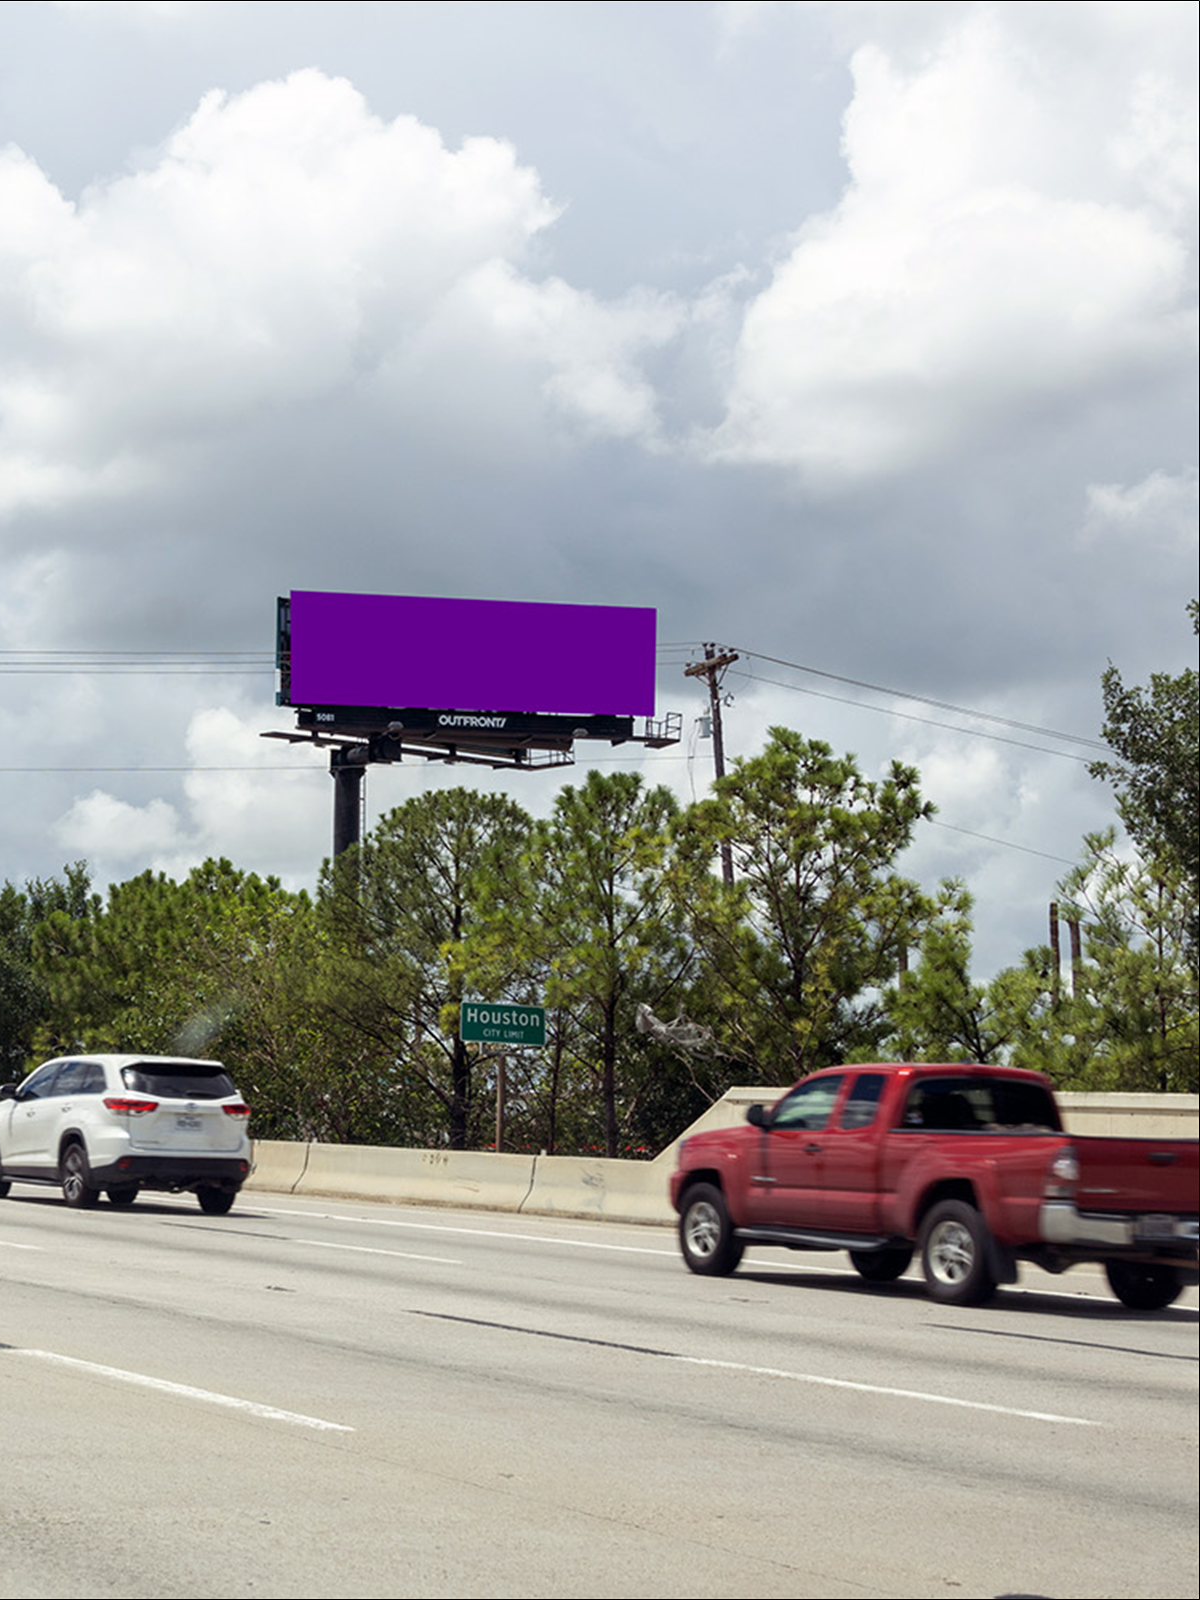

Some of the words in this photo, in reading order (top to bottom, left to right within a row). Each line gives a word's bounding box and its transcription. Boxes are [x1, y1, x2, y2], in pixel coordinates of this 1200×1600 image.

[467, 1008, 540, 1027] Houston
[483, 1028, 501, 1038] CITY
[503, 1030, 525, 1039] LIMIT
